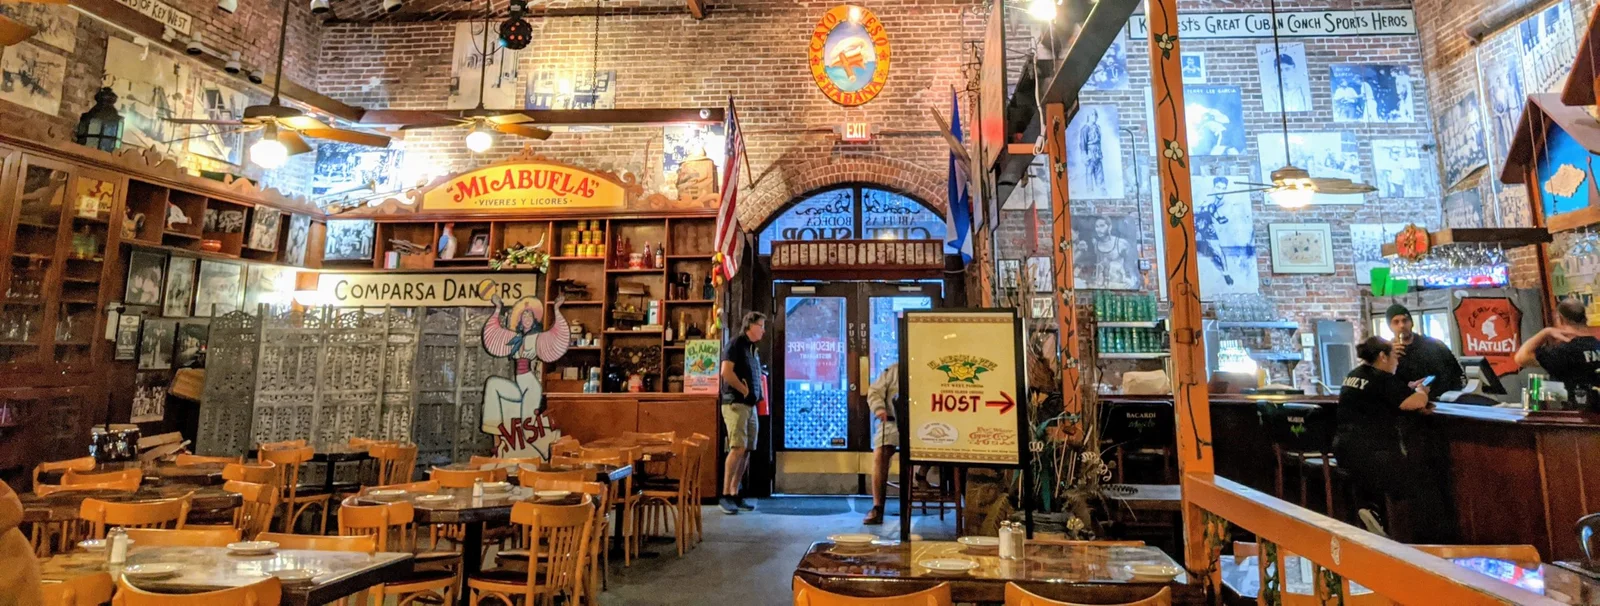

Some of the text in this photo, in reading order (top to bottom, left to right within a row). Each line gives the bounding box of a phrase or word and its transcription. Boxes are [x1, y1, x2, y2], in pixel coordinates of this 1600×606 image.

[152, 1, 166, 20] KEY
[167, 8, 187, 29] WEST
[1205, 16, 1240, 34] GREAT
[1245, 14, 1284, 33] CUBAN
[1287, 14, 1321, 33] CONCH
[1324, 13, 1368, 33] SPORTS
[1371, 12, 1408, 31] HEROS
[810, 12, 837, 53] CAYO
[821, 80, 883, 105] HABANA
[846, 122, 867, 138] EXIT
[478, 199, 517, 207] VIVERES
[335, 278, 522, 302] COMPARSA DANRS
[1468, 306, 1511, 328] CERVEZA
[1466, 333, 1517, 352] HATUEY
[931, 393, 981, 412] HOST
